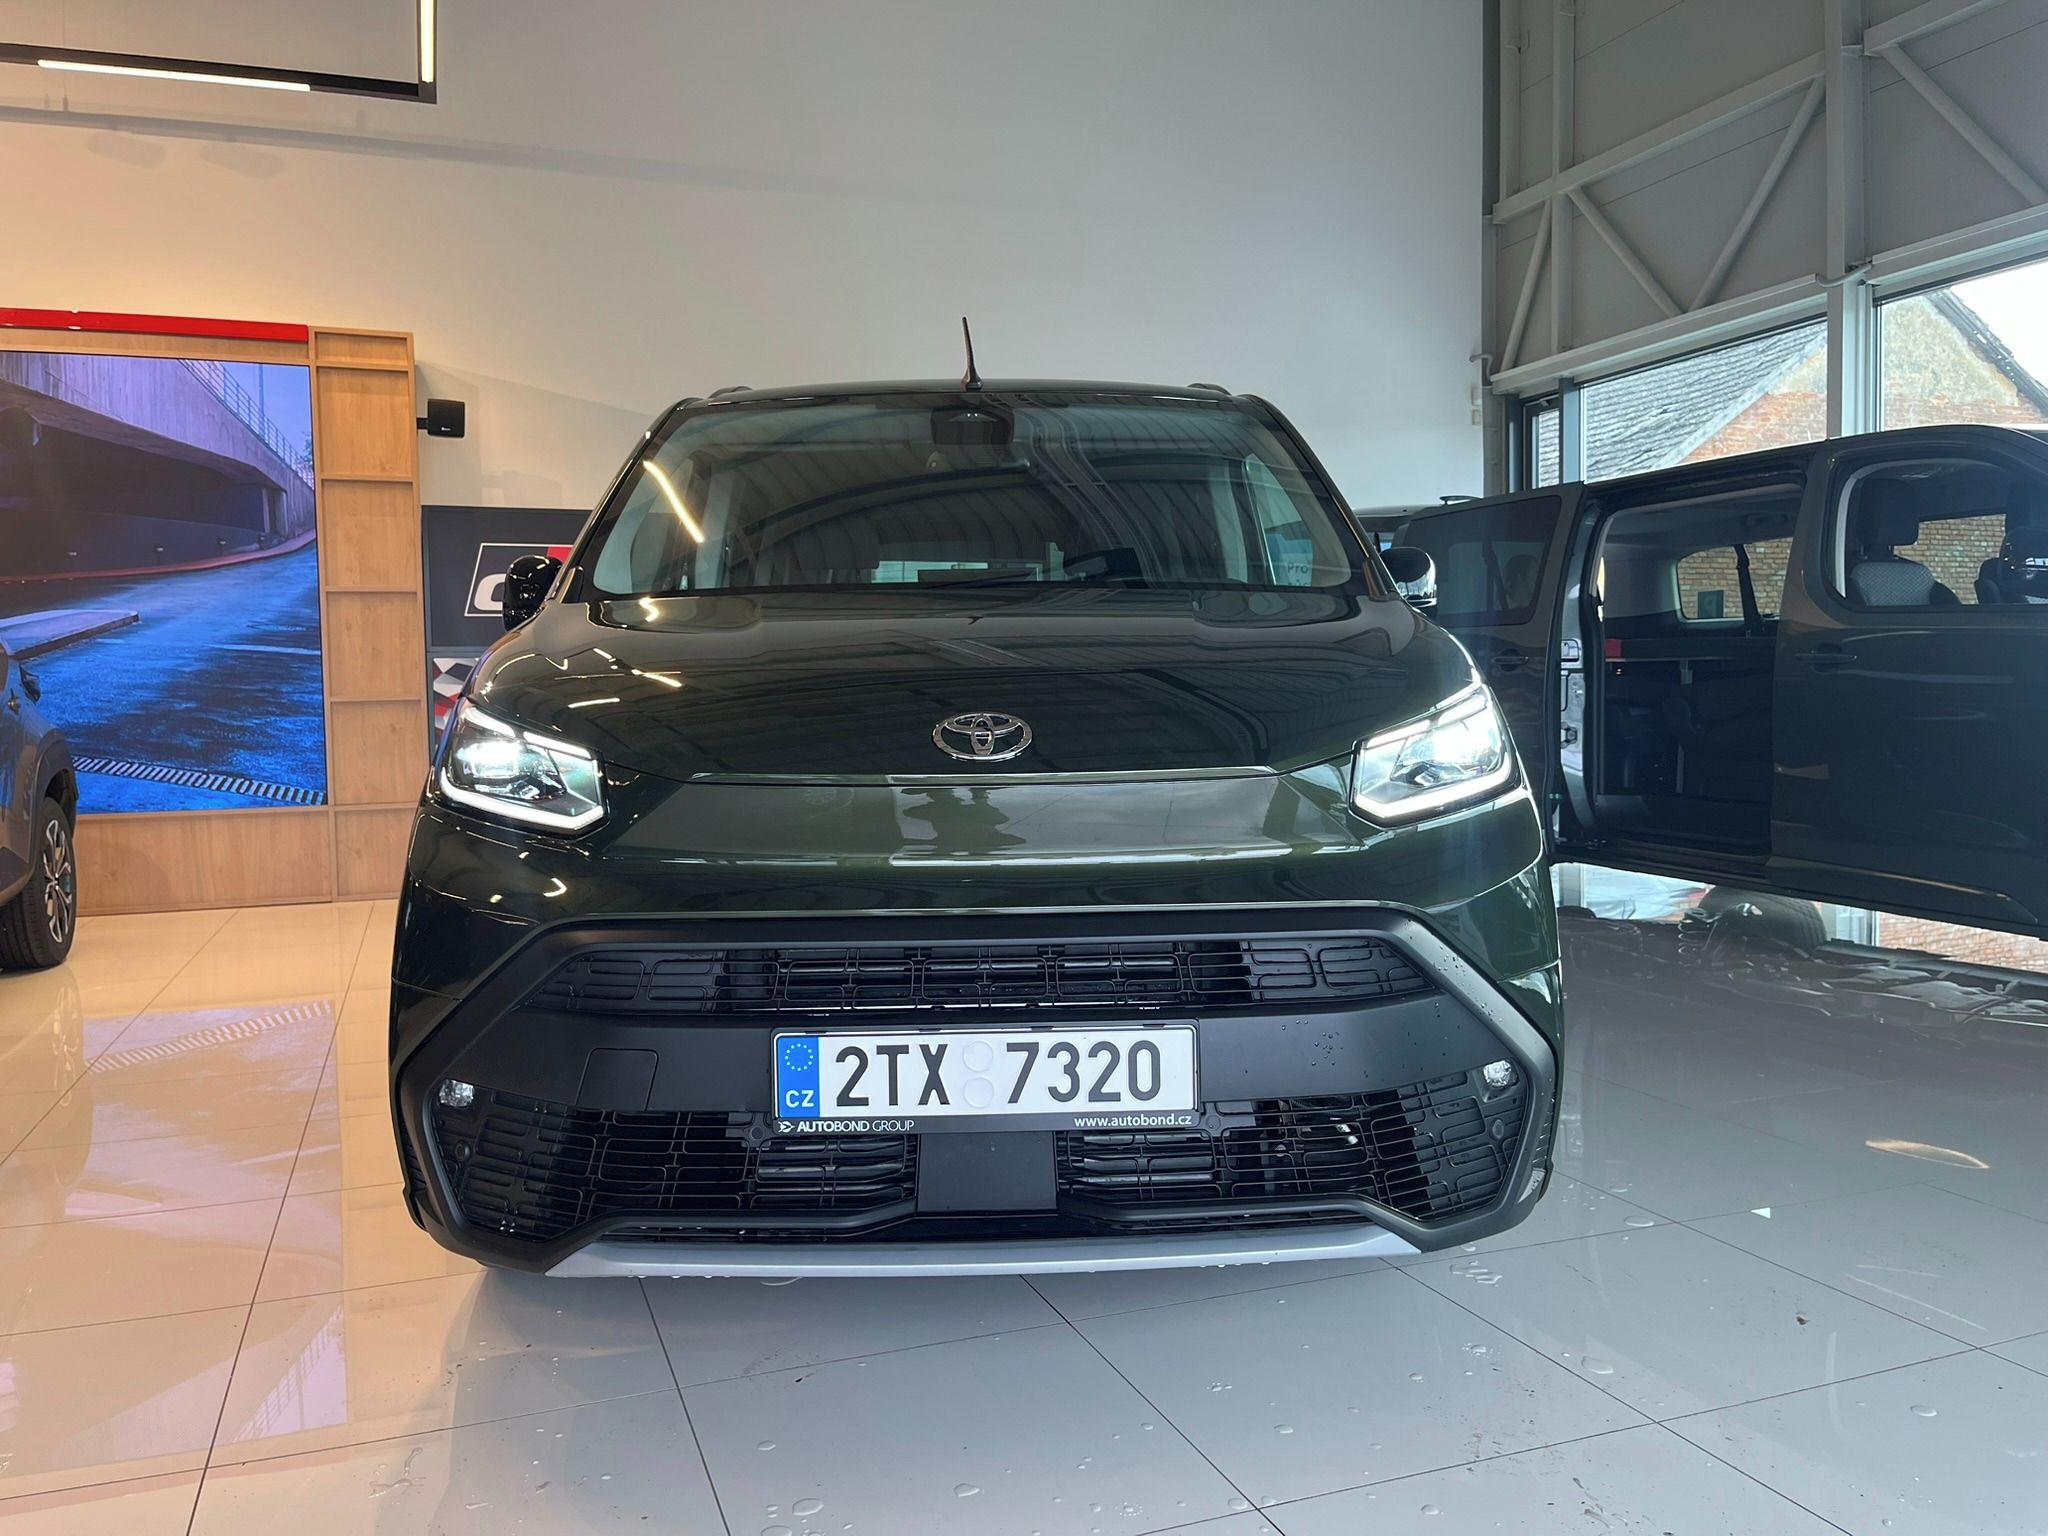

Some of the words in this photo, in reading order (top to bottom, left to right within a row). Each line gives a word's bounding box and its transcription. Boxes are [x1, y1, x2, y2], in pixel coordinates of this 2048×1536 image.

[835, 1044, 950, 1107] 2TX
[1006, 1040, 1161, 1104] 7320
[785, 1089, 815, 1108] CZ
[796, 1120, 870, 1133] AUTOBOND
[872, 1120, 915, 1132] GROUP
[1074, 1113, 1192, 1127] www.autobond.cz
